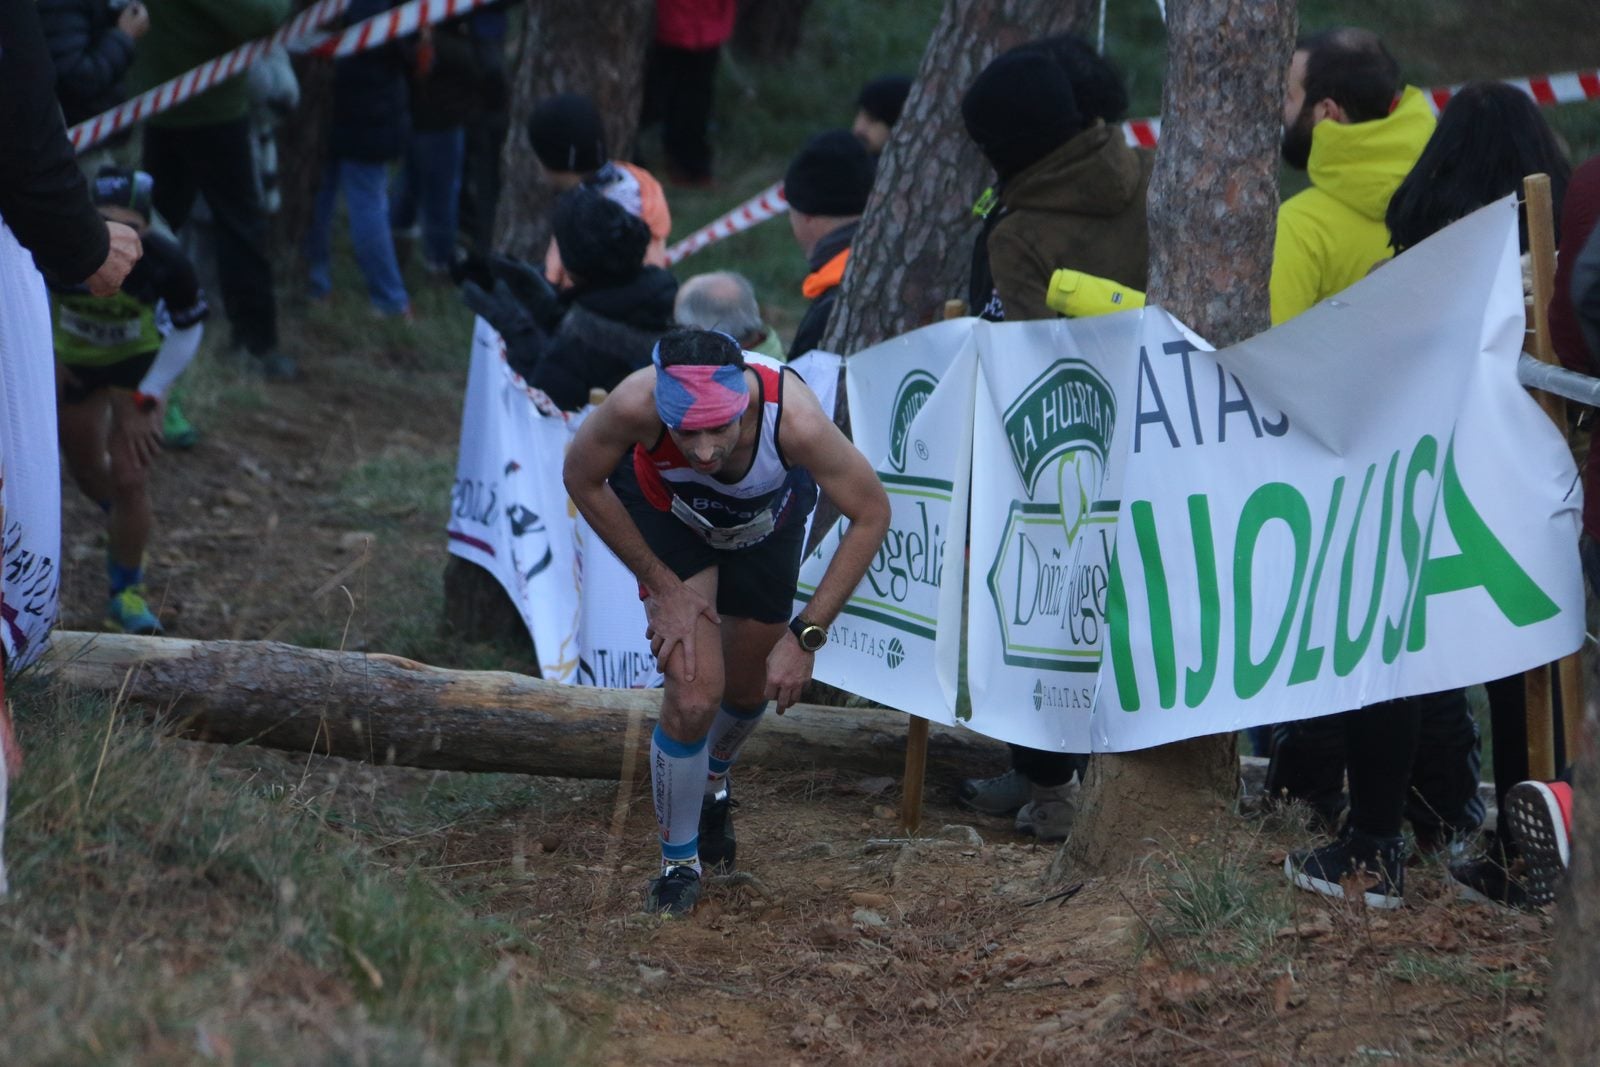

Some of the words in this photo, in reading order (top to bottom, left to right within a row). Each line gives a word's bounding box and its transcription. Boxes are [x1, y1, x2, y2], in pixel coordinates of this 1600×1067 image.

[1010, 415, 1038, 463] LA
[1042, 381, 1103, 440] HUERTA
[830, 625, 886, 659] ATATAS
